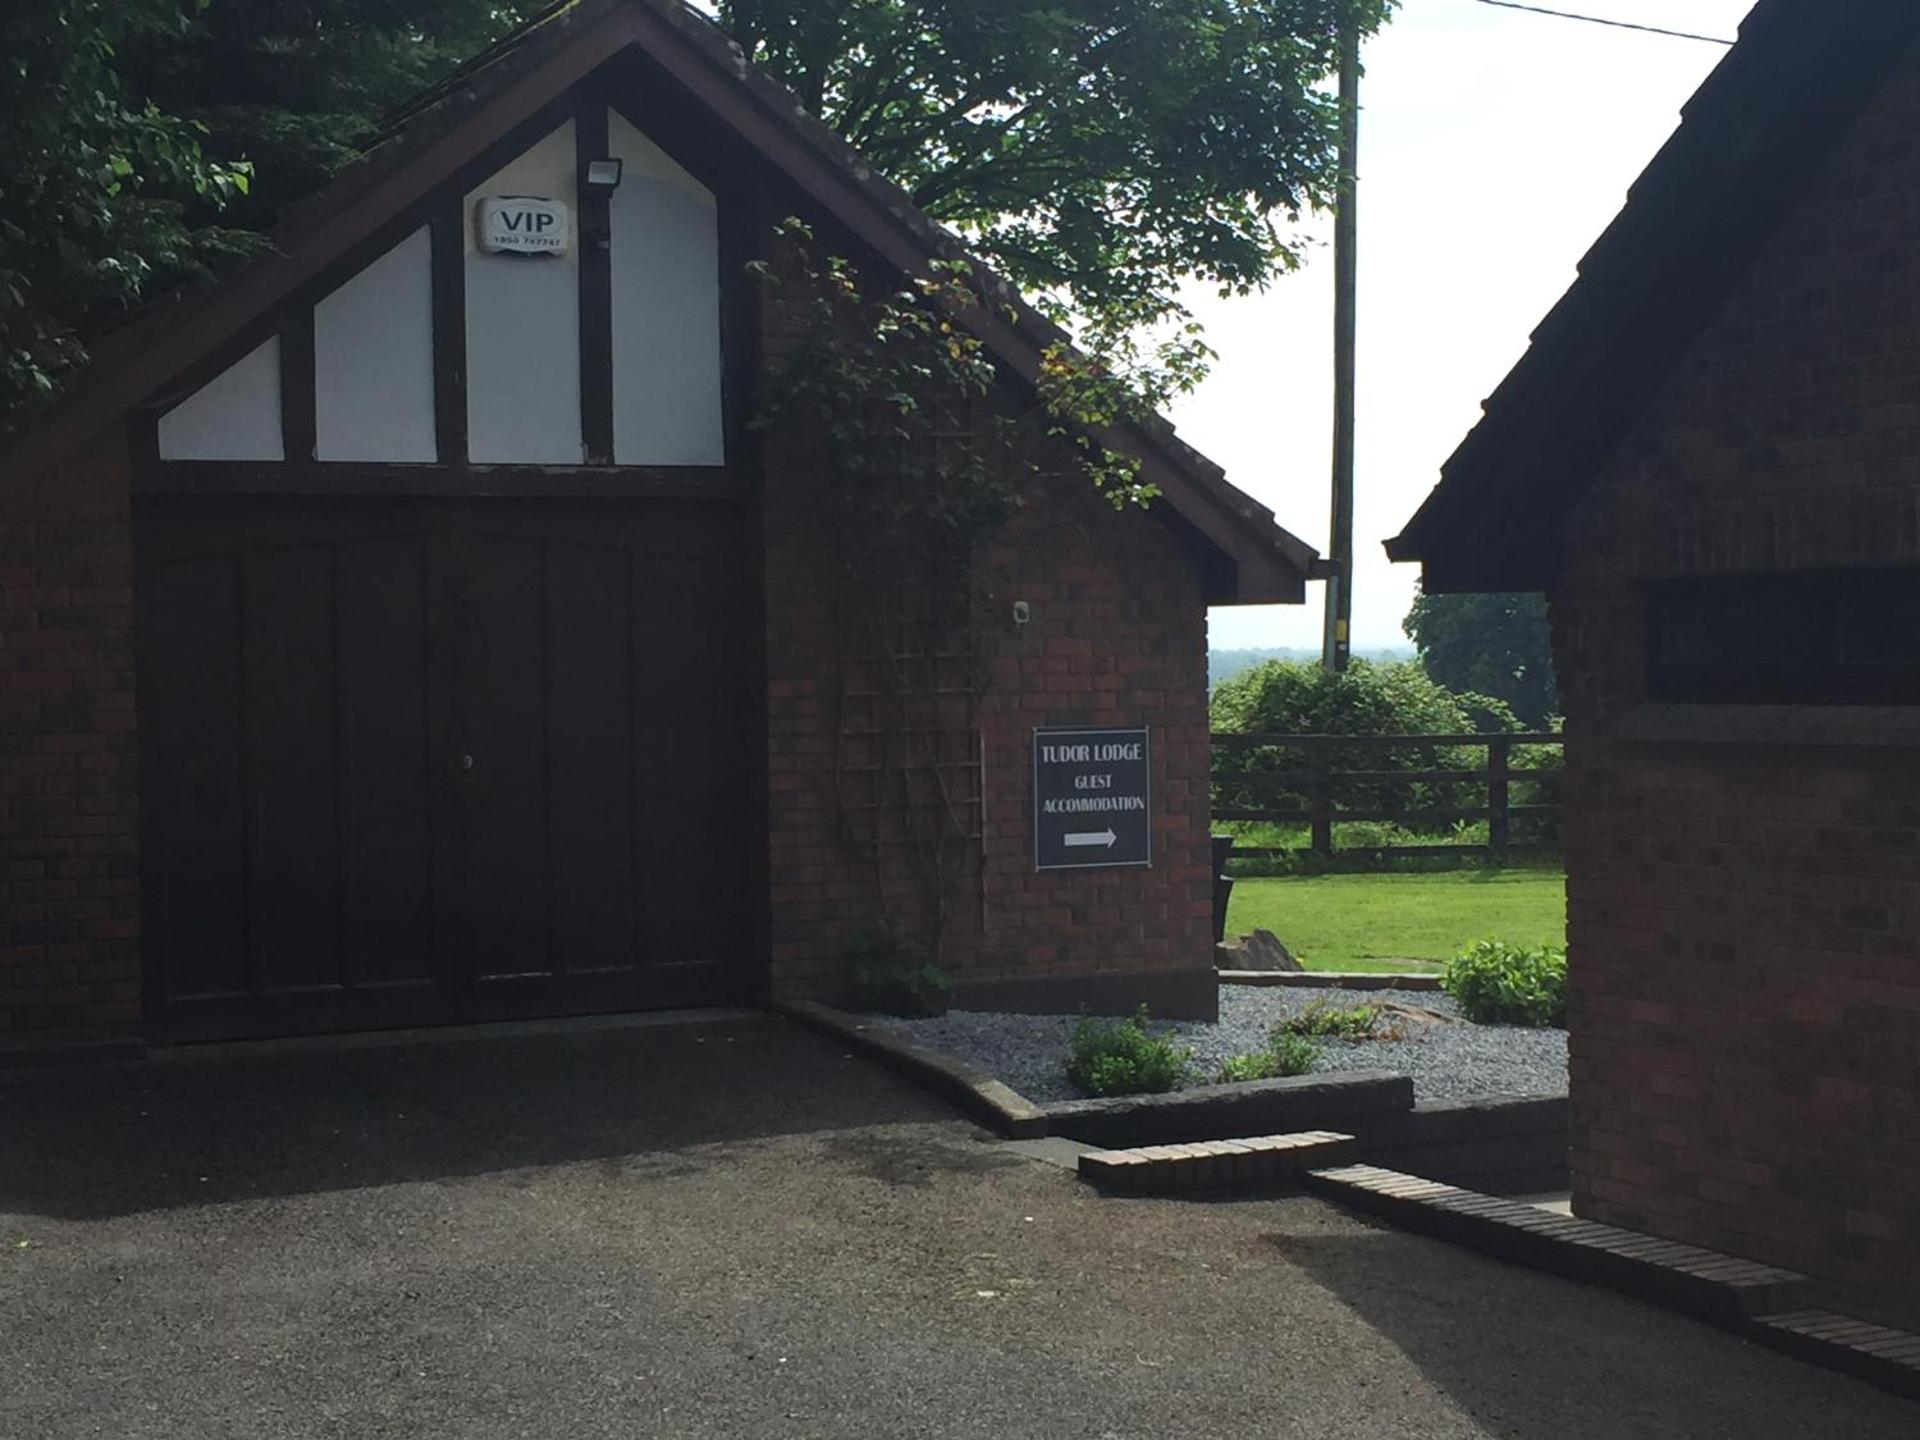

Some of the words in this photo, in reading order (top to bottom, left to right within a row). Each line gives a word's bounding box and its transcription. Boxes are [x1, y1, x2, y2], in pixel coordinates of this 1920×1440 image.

[500, 211, 554, 233] VIP
[1042, 744, 1090, 763] TUDOR
[1094, 743, 1142, 762] LODGE
[1074, 774, 1113, 790] GUEST
[1043, 796, 1145, 814] ACCOMMODATION
